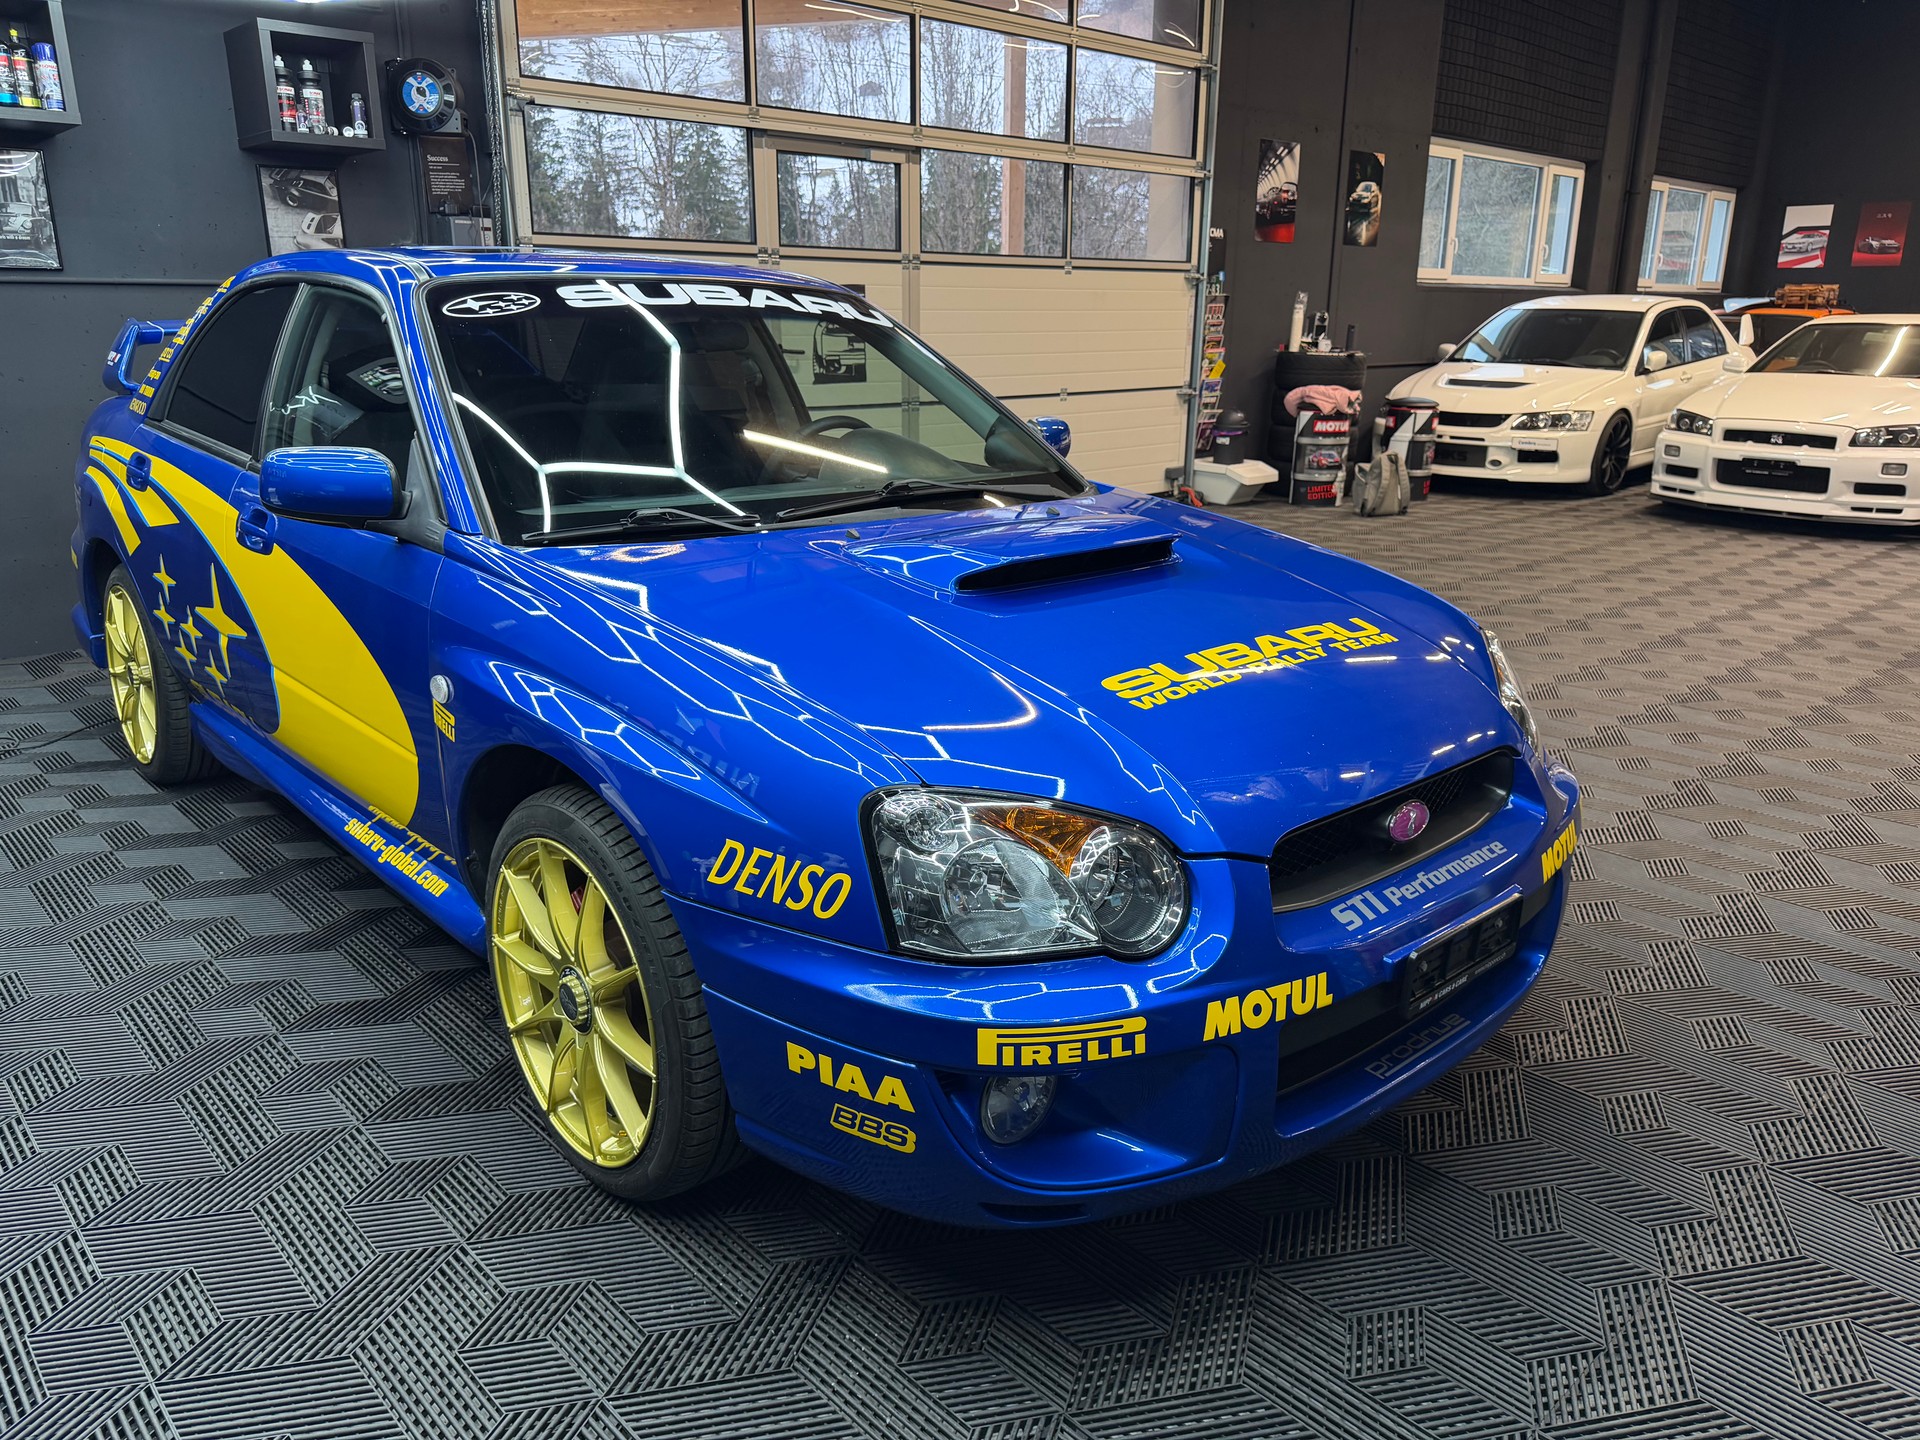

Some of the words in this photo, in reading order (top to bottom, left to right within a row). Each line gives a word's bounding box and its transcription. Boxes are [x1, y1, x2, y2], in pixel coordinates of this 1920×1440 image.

[426, 154, 448, 162] Success
[557, 282, 894, 328] SUBARU
[1308, 484, 1336, 493] LIMITE
[1101, 617, 1381, 699] SUBARU
[1129, 671, 1242, 711] WORLD
[1250, 646, 1328, 673] RALLY
[1329, 633, 1399, 653] TEAM
[432, 698, 455, 743] PIRELLI
[344, 818, 449, 898] subaru-global.com
[706, 838, 852, 919] DENSO
[1330, 890, 1389, 931] STI
[1383, 840, 1507, 907] Performance
[1541, 819, 1577, 885] MOTUL
[1203, 972, 1333, 1041] MOTUL
[977, 1016, 1147, 1066] PIRELLI
[1364, 1013, 1466, 1080] prodrive
[786, 1041, 915, 1113] PIAA
[830, 1103, 917, 1153] BBS
